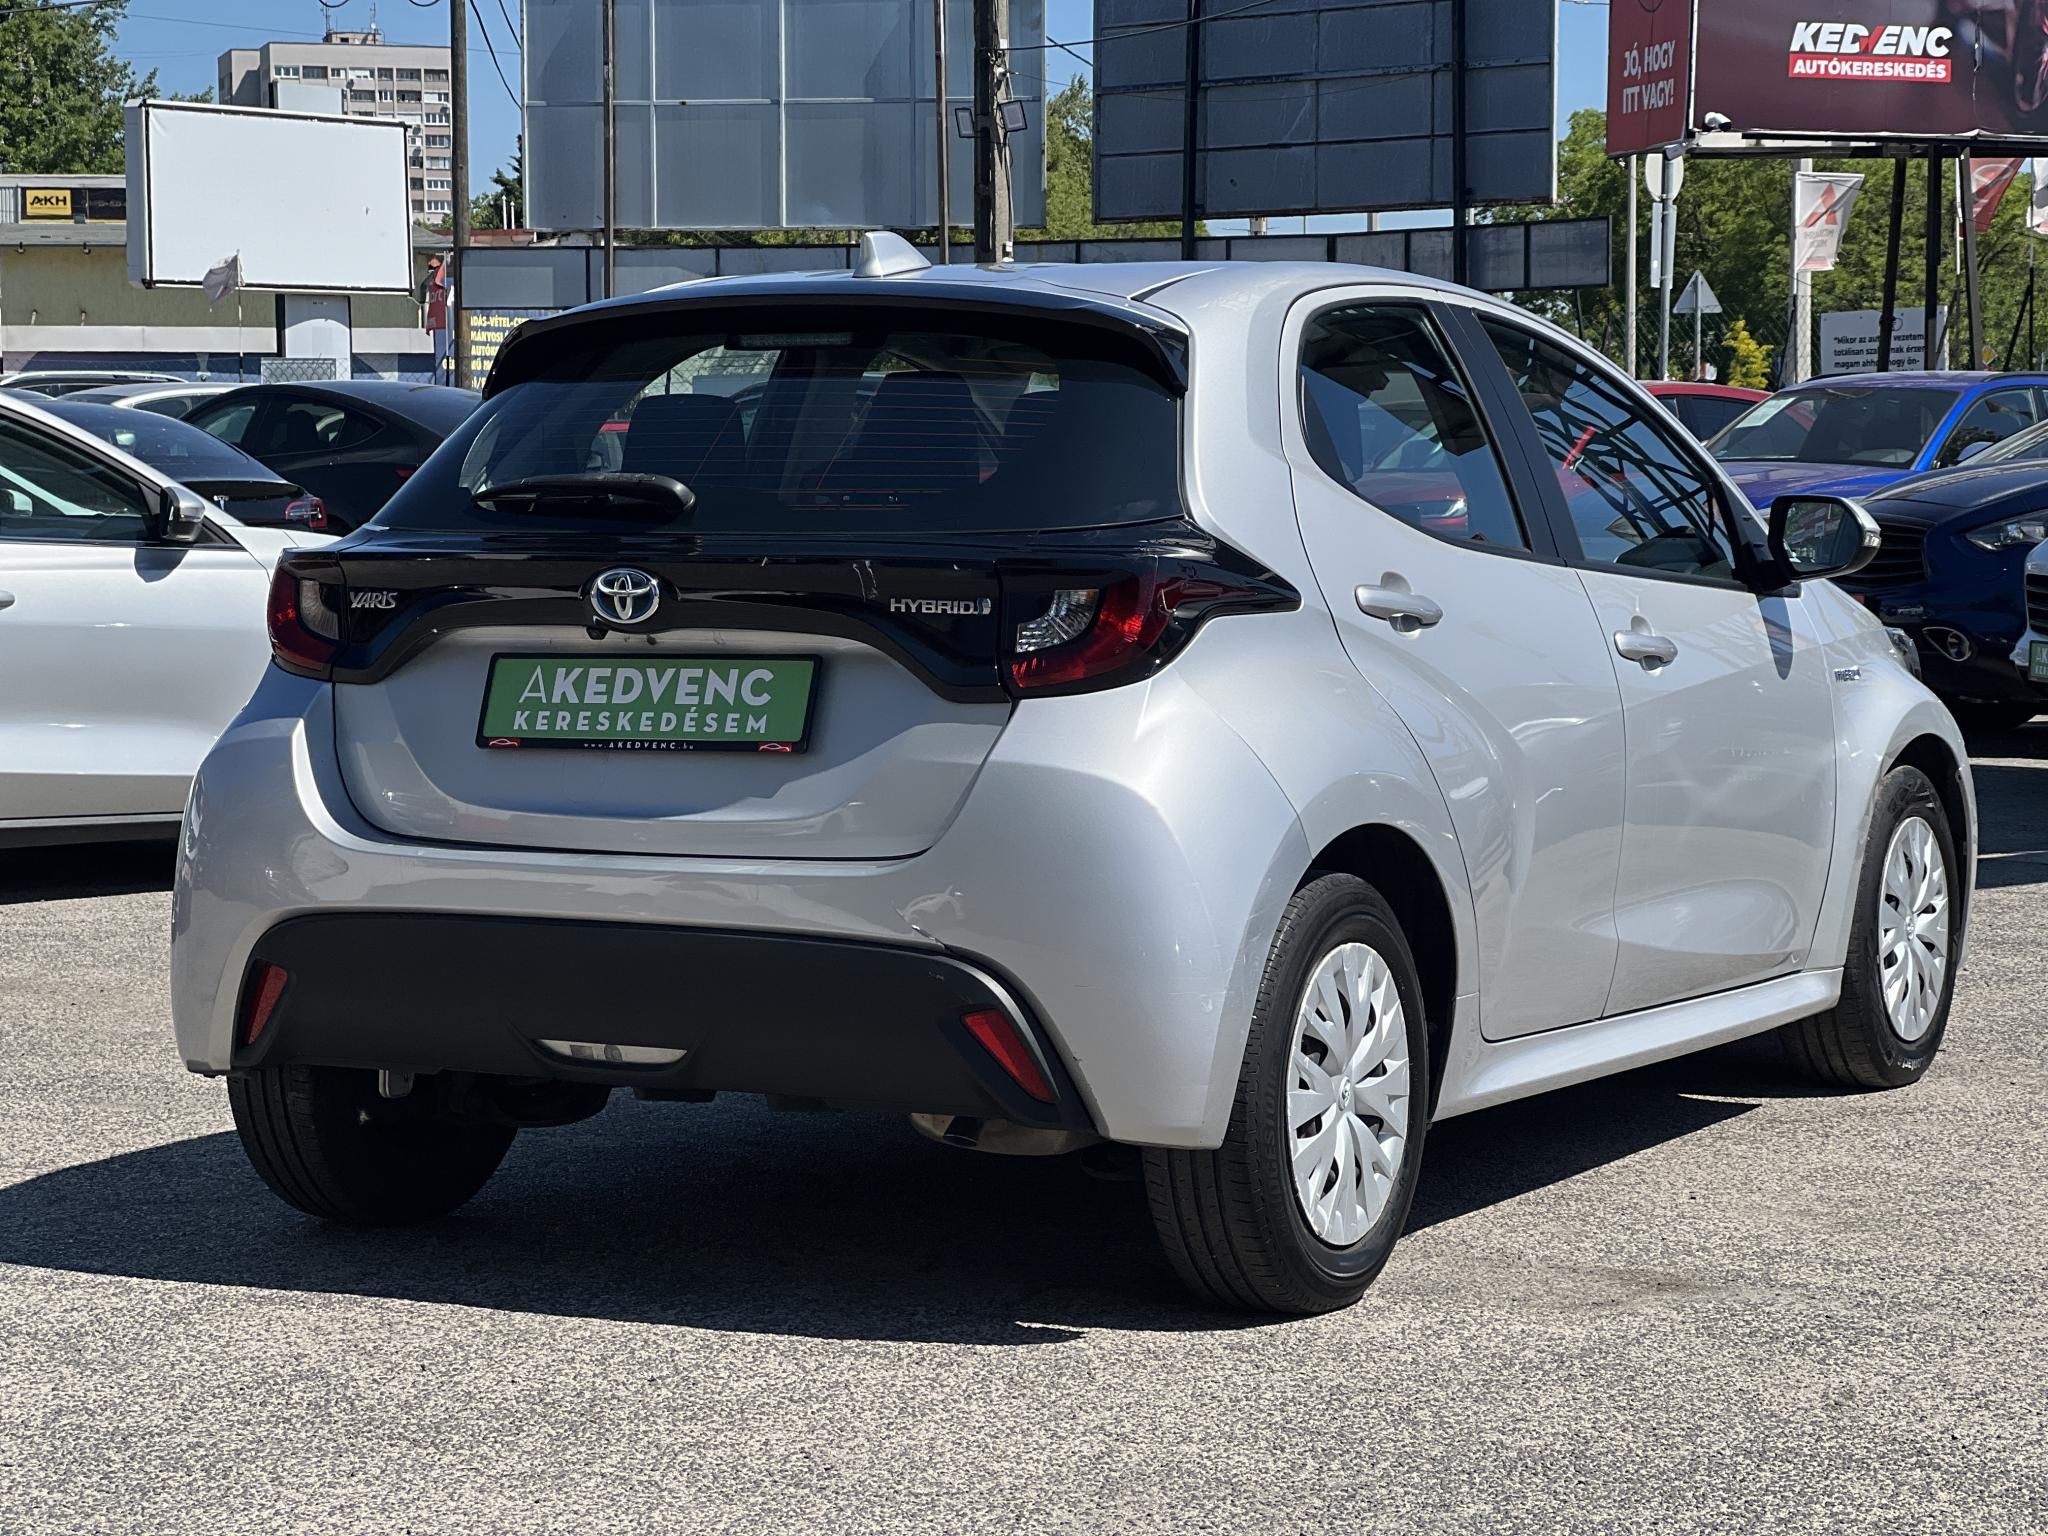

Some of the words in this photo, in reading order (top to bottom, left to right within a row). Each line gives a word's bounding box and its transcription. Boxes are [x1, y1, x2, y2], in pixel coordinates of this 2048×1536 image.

[1623, 42, 1641, 80] JÓ,
[1644, 40, 1675, 73] HOGY
[1793, 57, 1947, 80] AUTÓKERESKEDÉS
[1622, 85, 1640, 114] ITT
[1642, 78, 1674, 111] VAGY!
[890, 598, 978, 615] HYBRID
[513, 707, 768, 734] KERESKEDÉSEM
